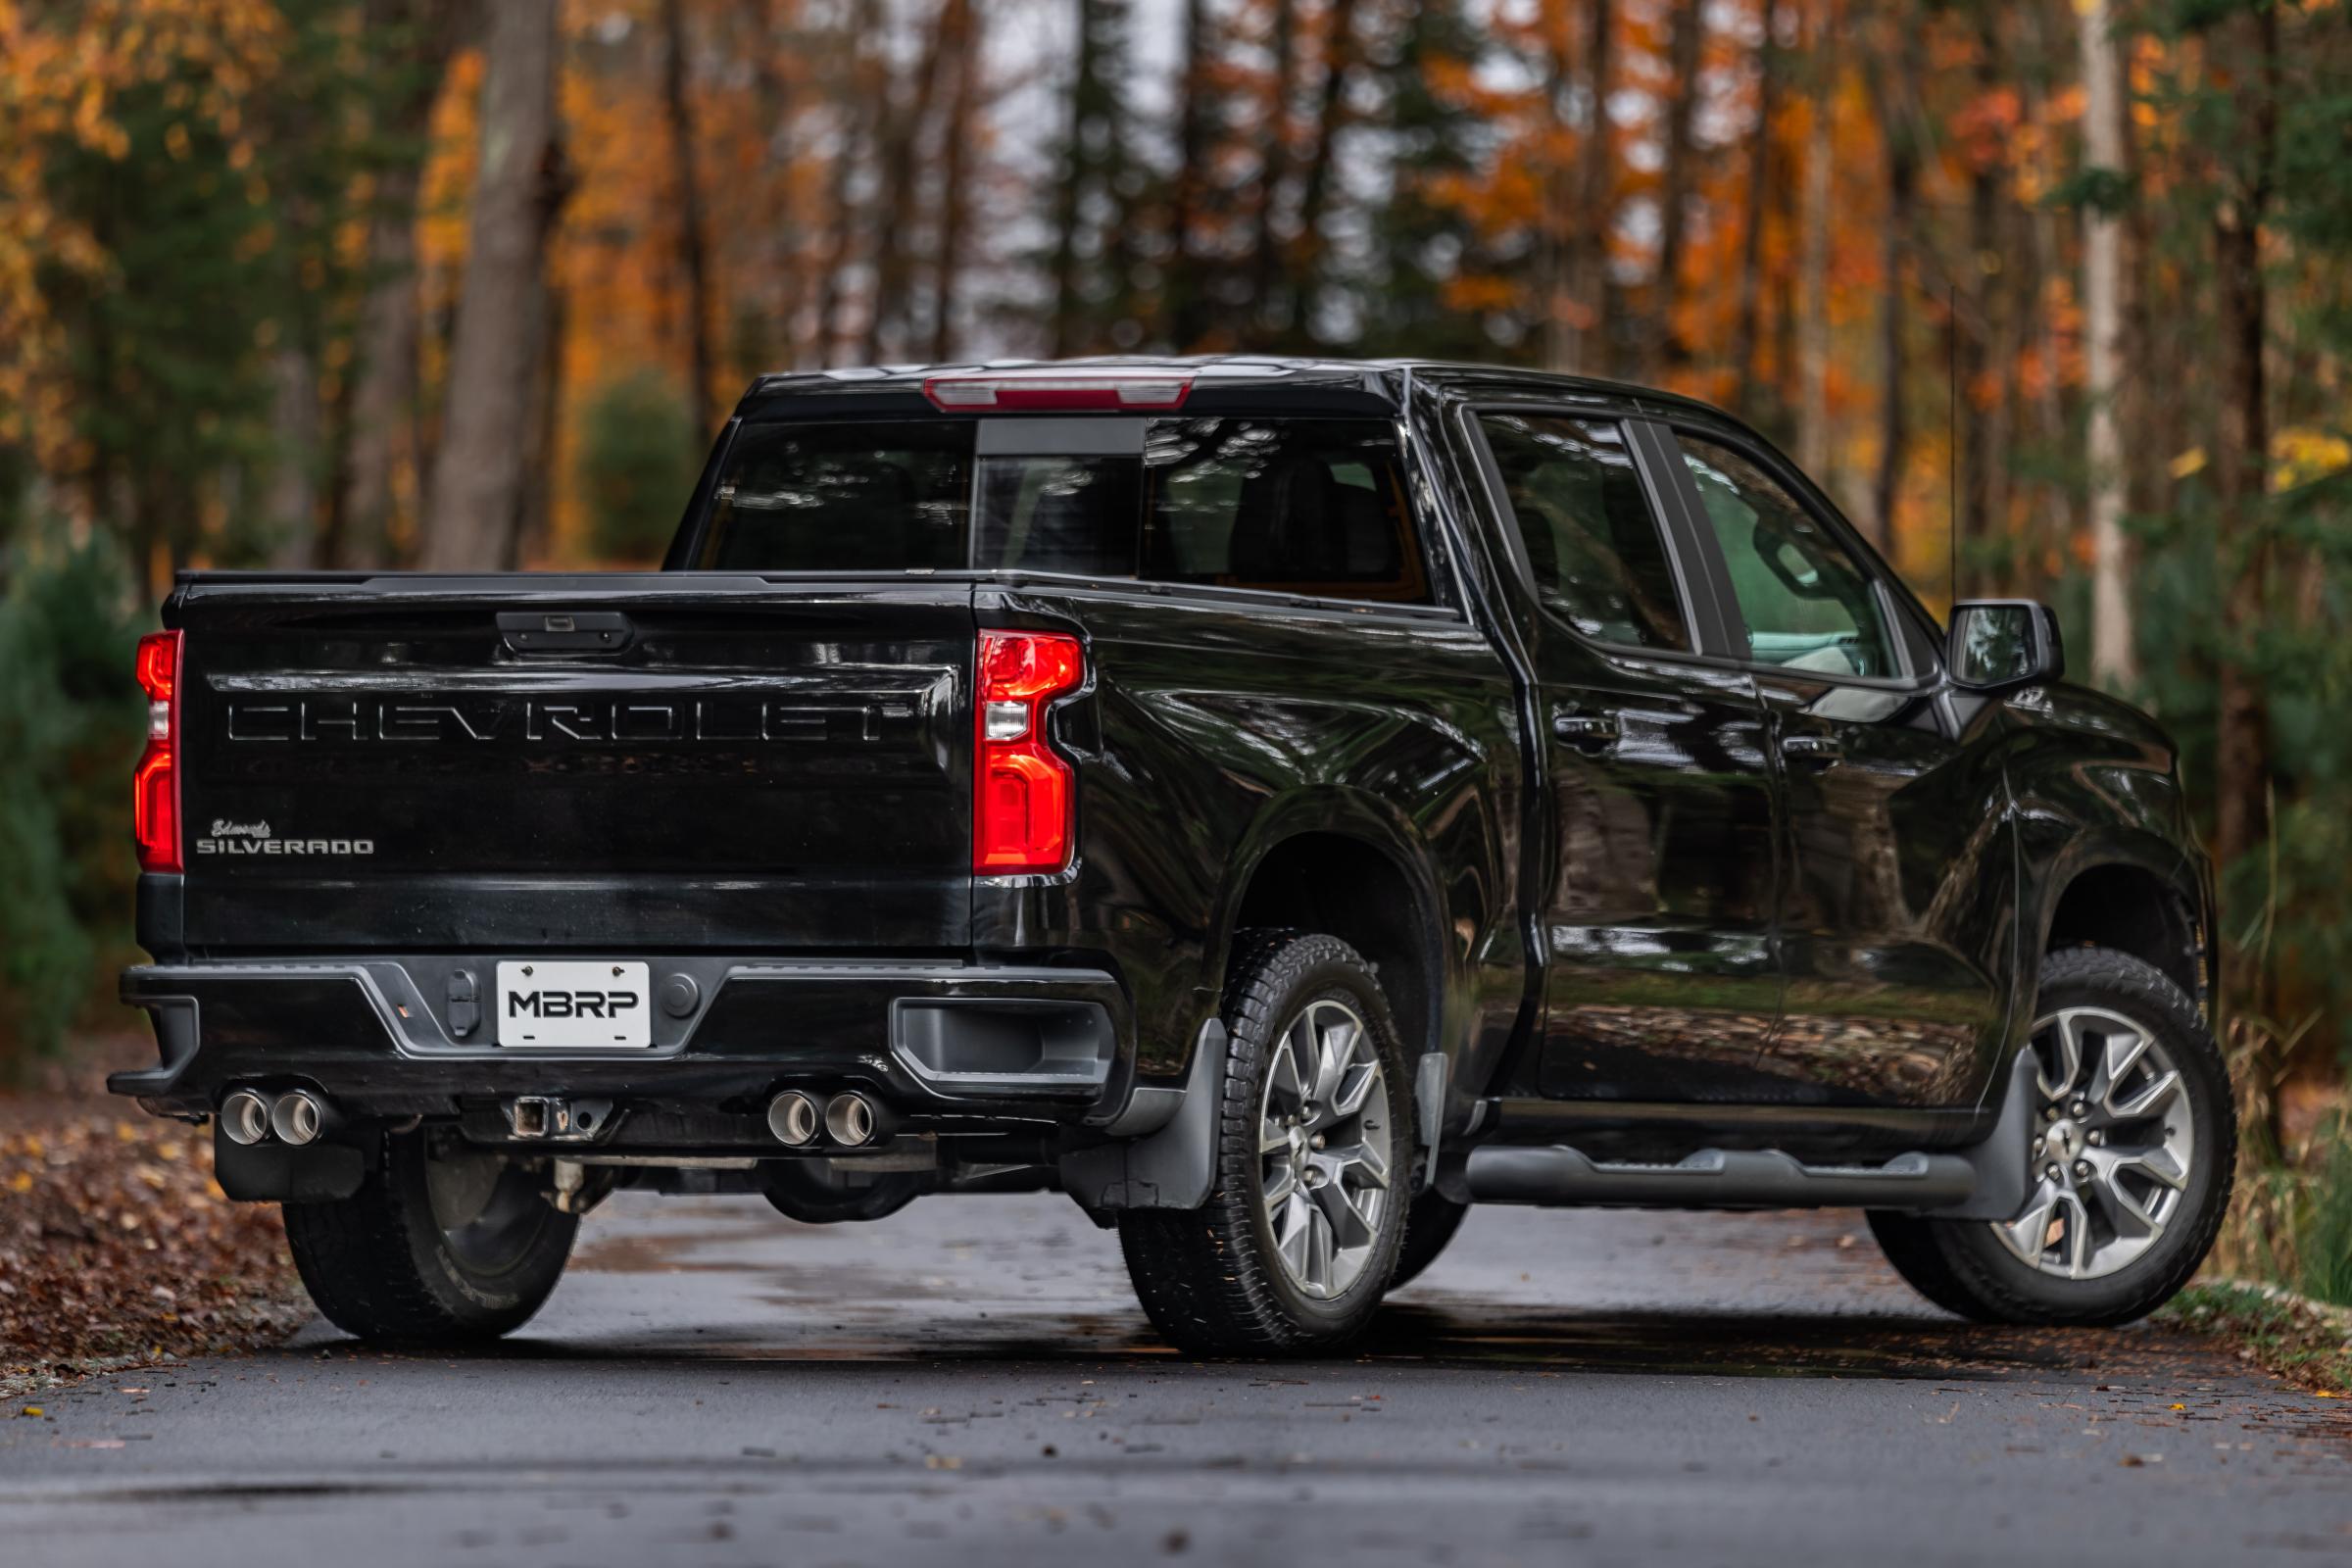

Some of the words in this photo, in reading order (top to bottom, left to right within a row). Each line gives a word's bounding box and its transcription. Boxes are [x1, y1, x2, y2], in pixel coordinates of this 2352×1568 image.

[227, 700, 911, 742] CHEVROLET
[196, 839, 374, 855] SILVERADO
[508, 991, 639, 1018] MBRP
